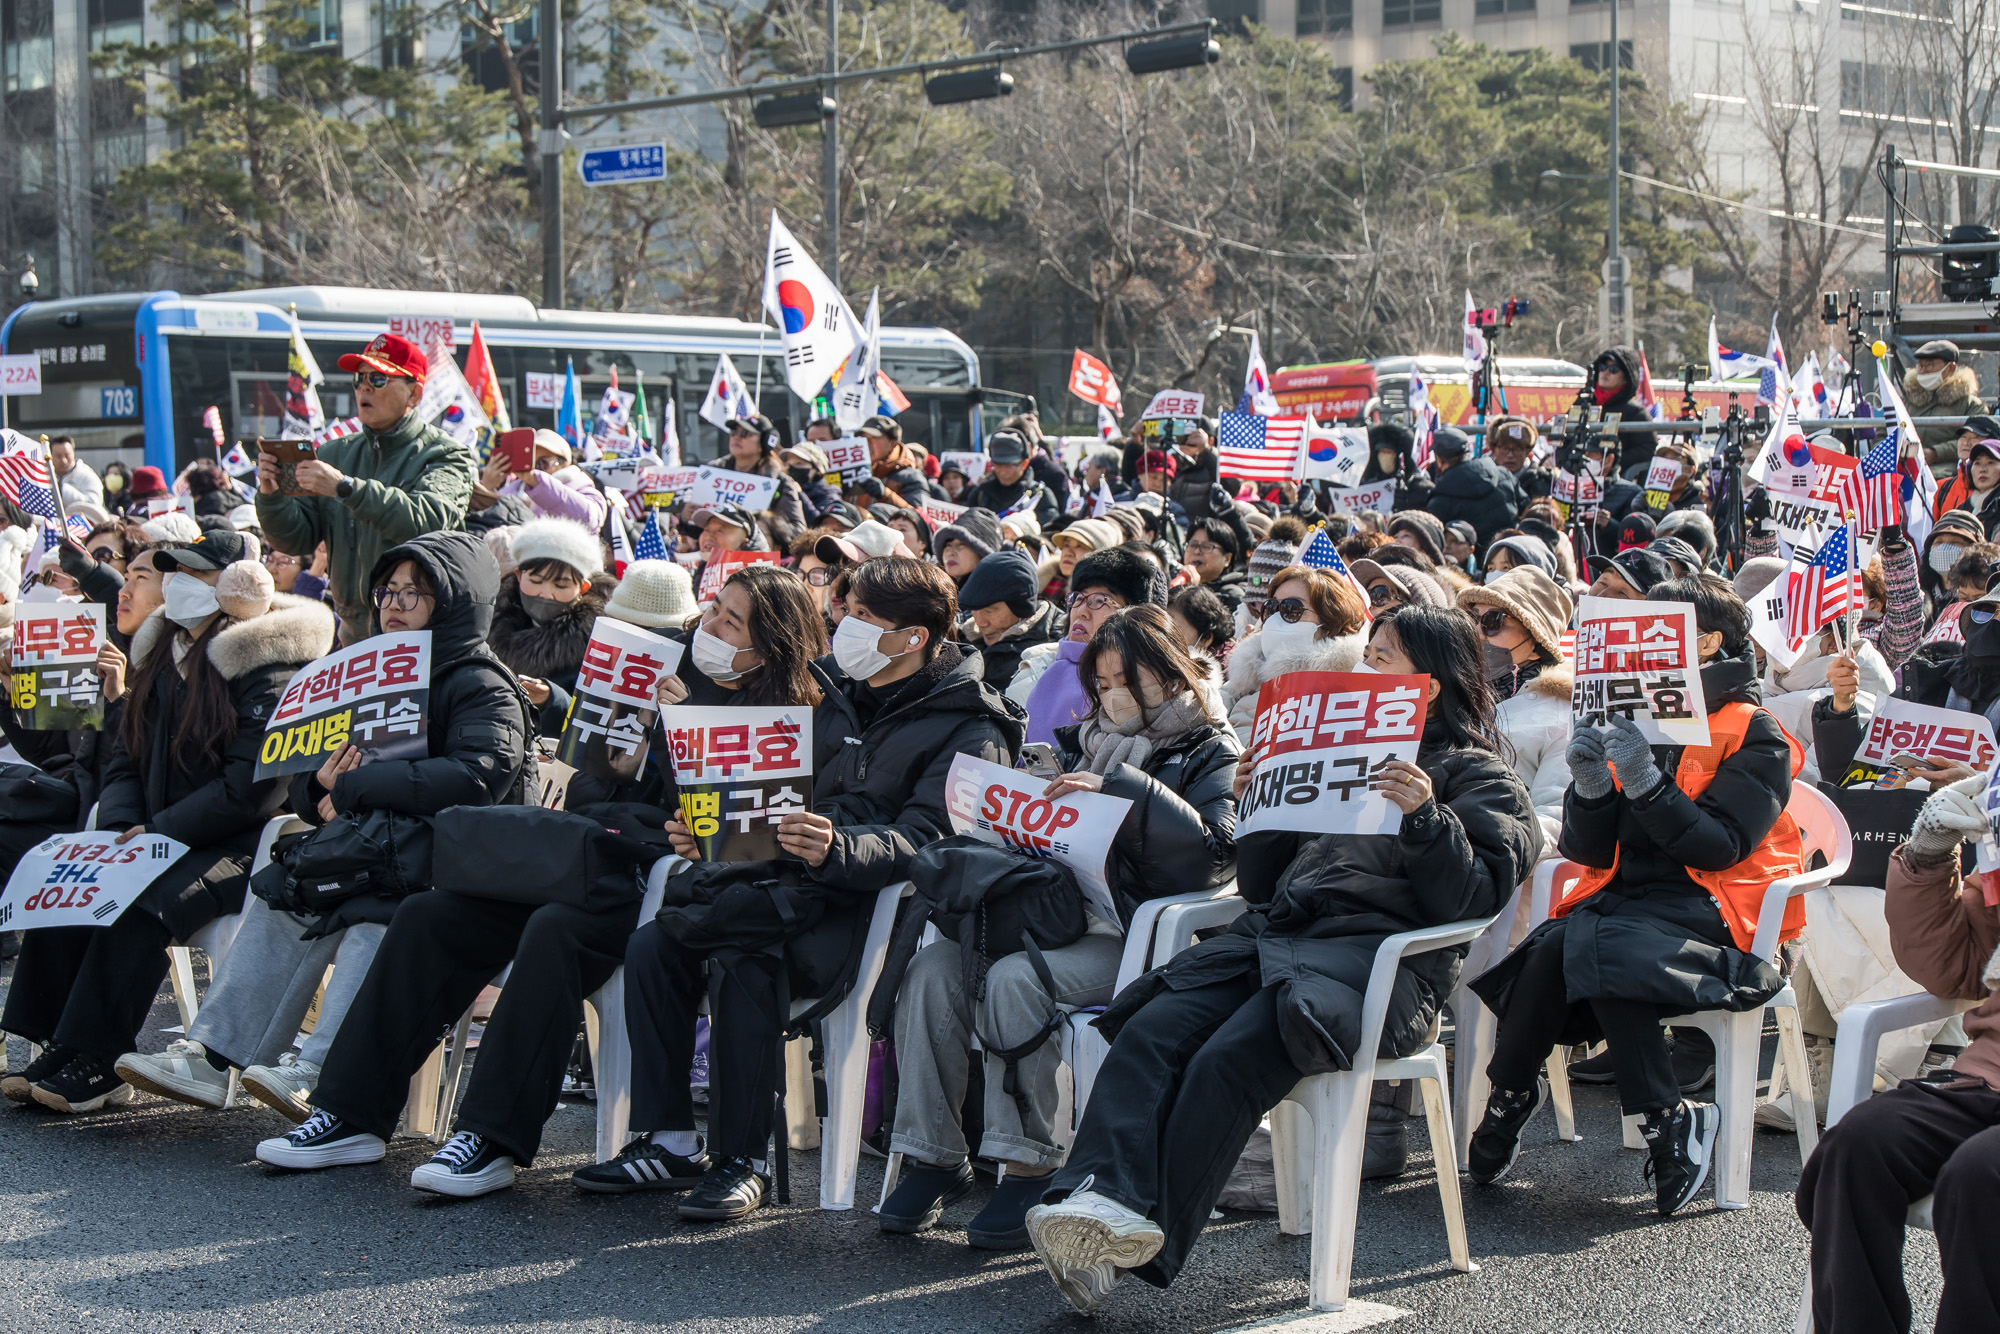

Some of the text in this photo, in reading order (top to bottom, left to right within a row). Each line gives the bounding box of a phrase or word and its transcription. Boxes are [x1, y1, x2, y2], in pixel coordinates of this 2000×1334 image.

[104, 388, 135, 416] 703
[712, 477, 756, 493] STOP
[715, 490, 745, 506] THE
[1344, 490, 1381, 508] STOP
[40, 667, 100, 708] 구속
[274, 643, 421, 721] 탄핵무효
[261, 696, 422, 765] 이재명 구속
[571, 700, 646, 757] 구속
[1252, 685, 1421, 759] 탄핵무효
[1240, 760, 1325, 823] 이재명
[980, 783, 1080, 838] STOP
[53, 843, 146, 864] STEAL
[45, 863, 105, 884] THE
[24, 886, 101, 912] STOP
[89, 1074, 104, 1085] FILA
